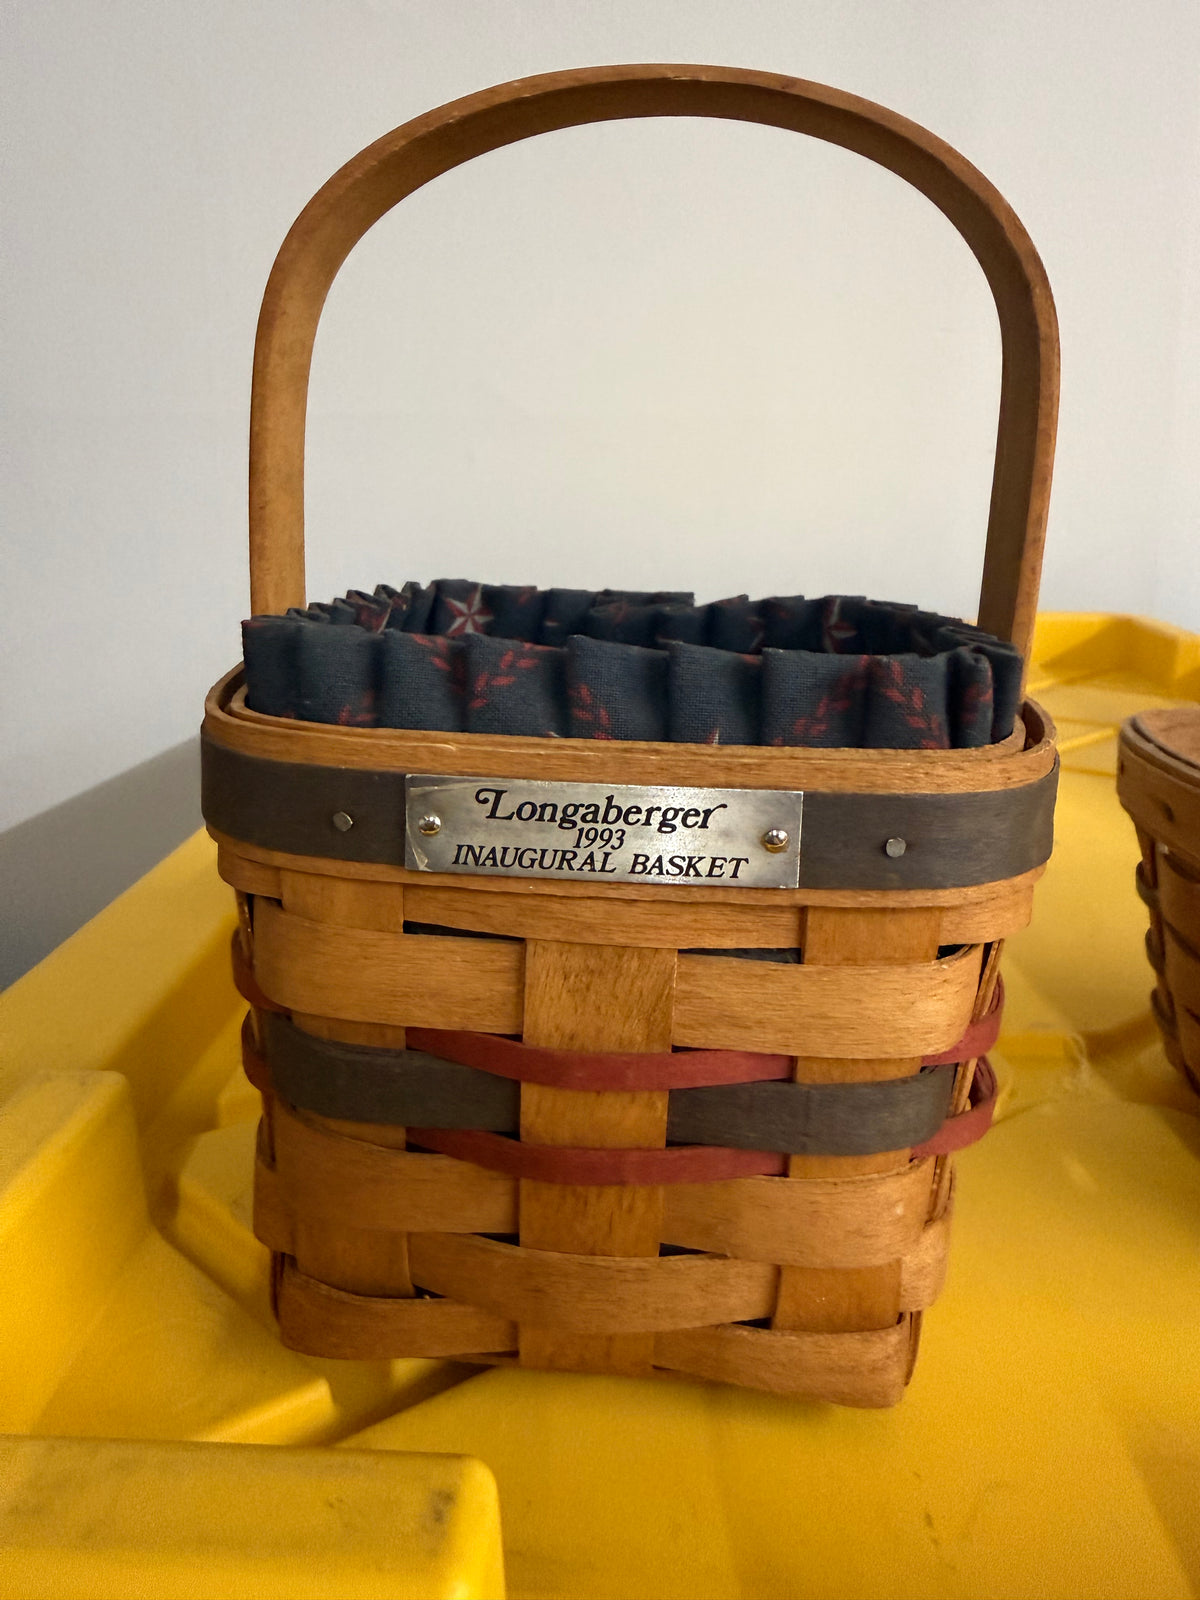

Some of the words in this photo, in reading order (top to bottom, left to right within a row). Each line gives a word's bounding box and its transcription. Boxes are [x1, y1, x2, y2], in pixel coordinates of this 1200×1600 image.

[474, 788, 728, 833] Longaberger
[573, 827, 625, 850] 1993
[452, 844, 616, 873] INAUGURAL
[628, 853, 749, 879] BASKET
